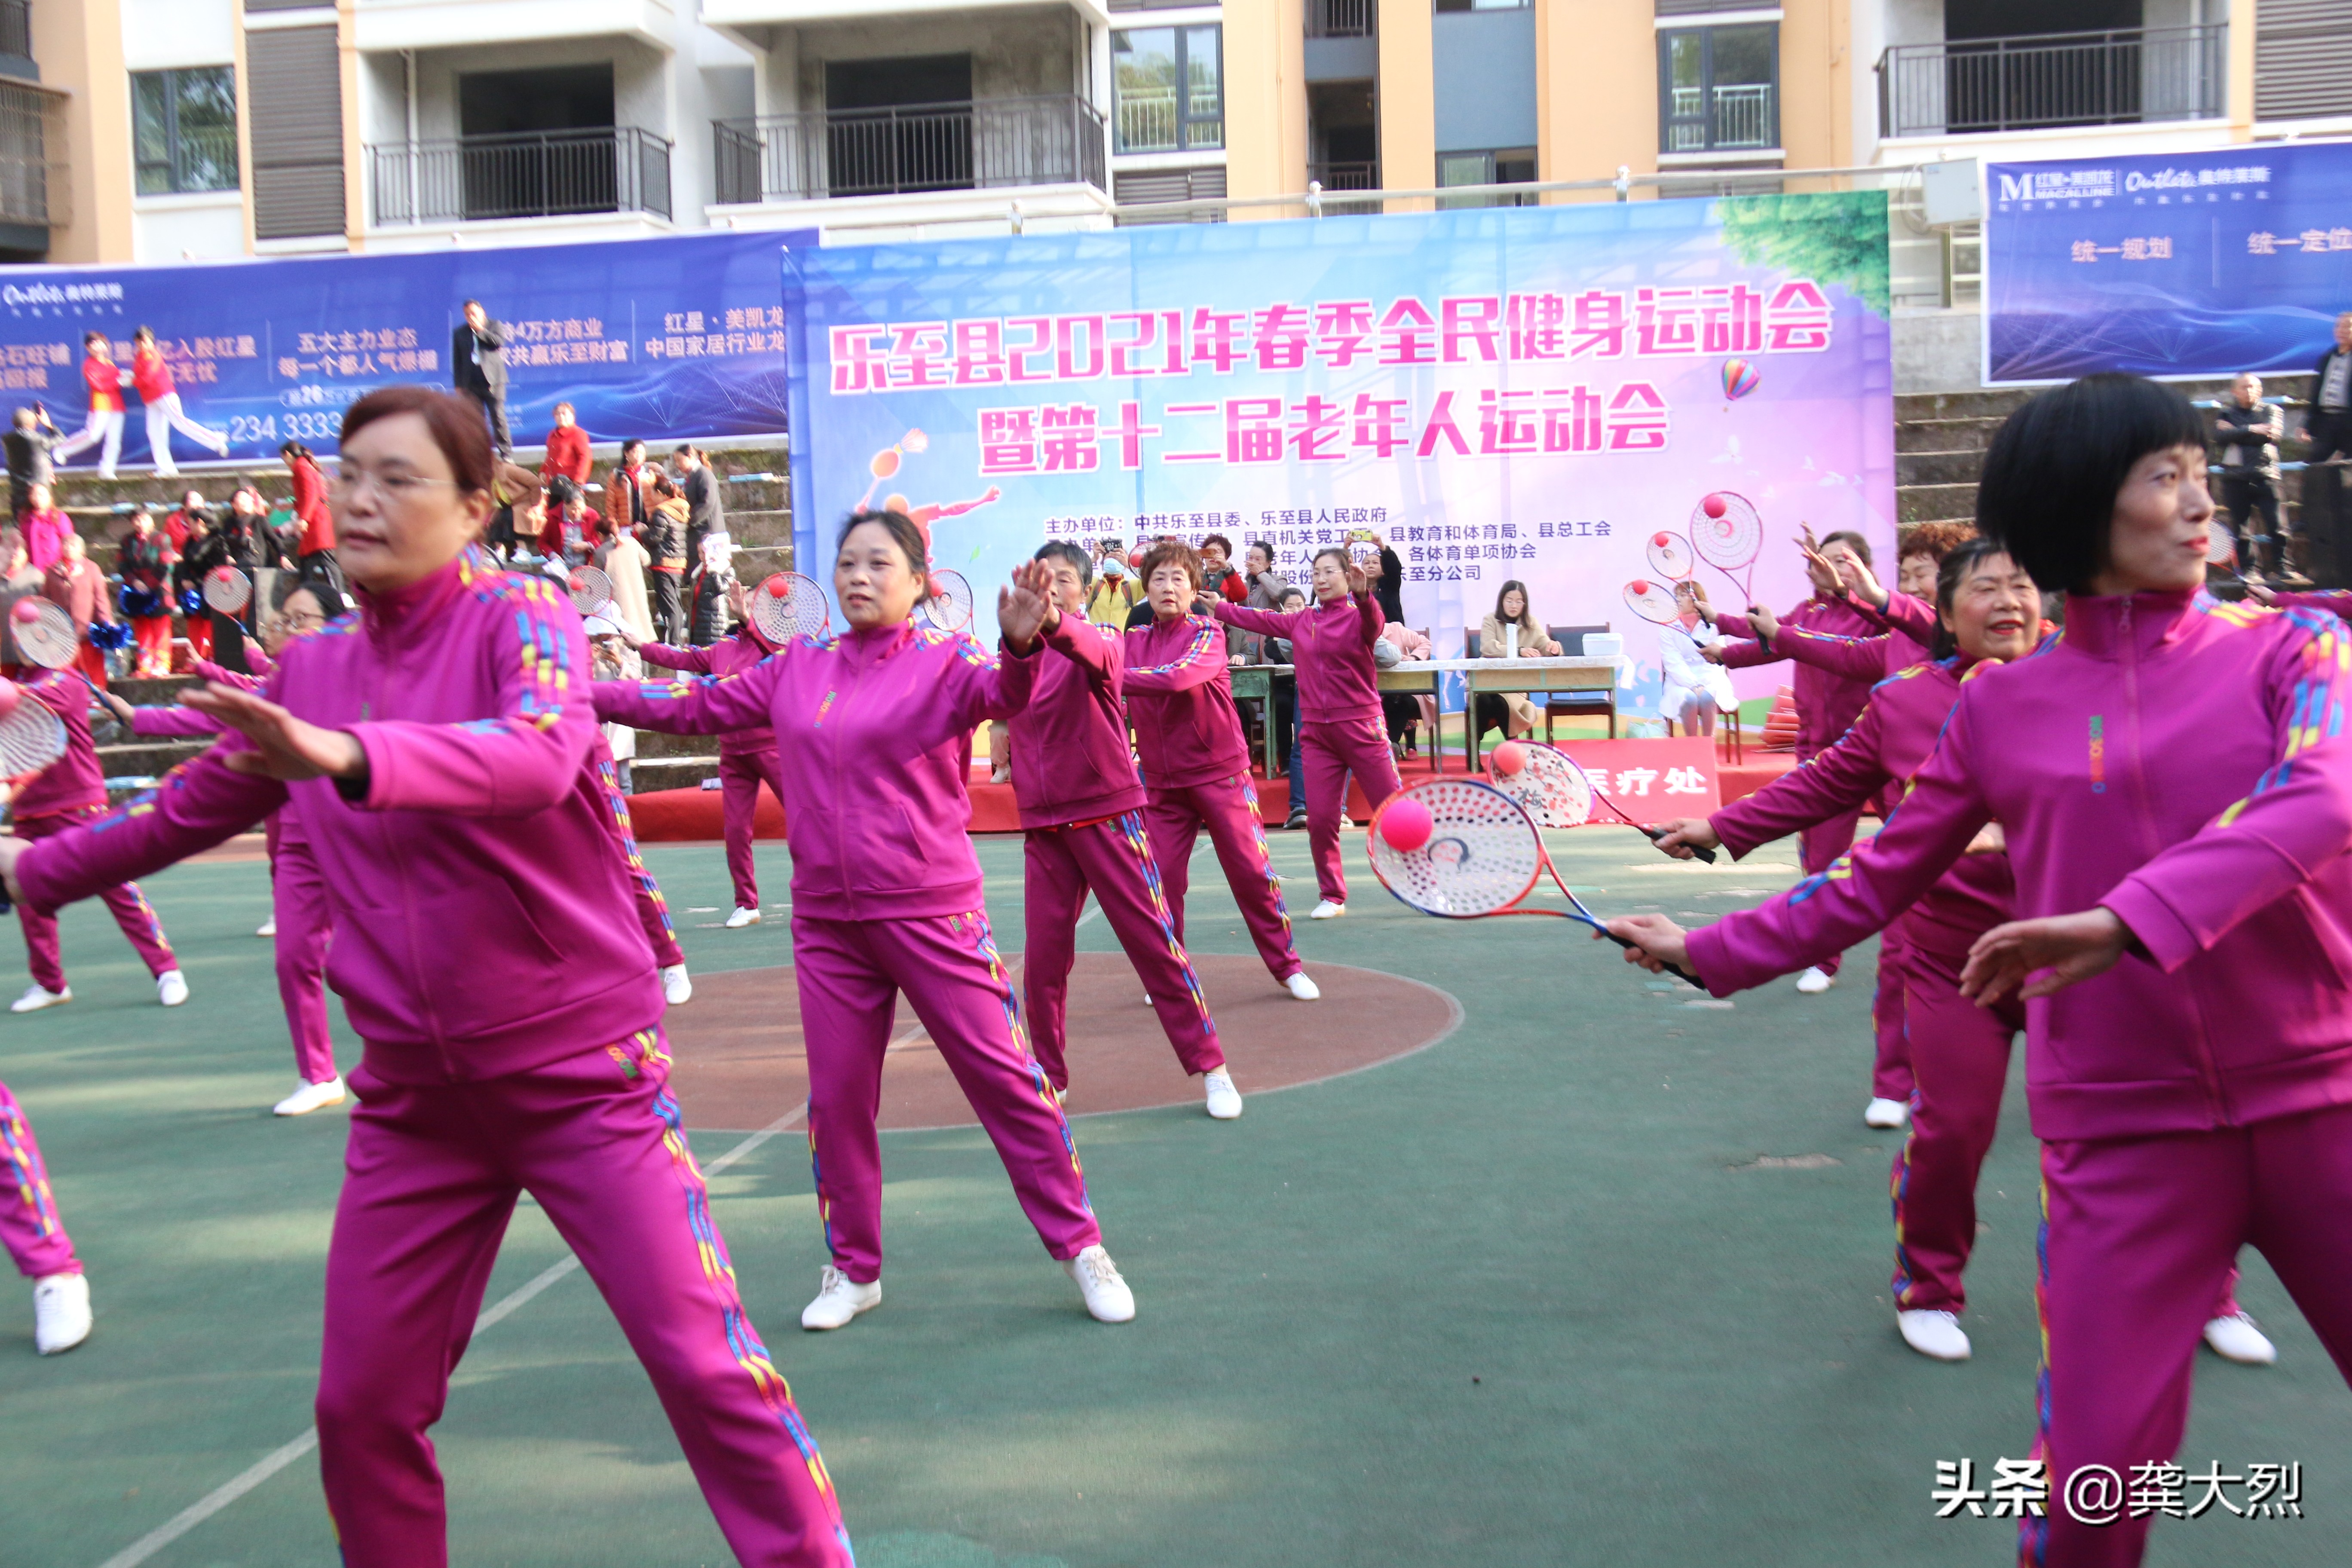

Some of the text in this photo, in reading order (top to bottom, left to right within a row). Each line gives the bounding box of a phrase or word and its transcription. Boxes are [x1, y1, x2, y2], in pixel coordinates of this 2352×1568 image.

[2071, 235, 2173, 263] 统一规划
[2247, 226, 2352, 254] 统一定位
[298, 327, 418, 354] 五大主力业态
[830, 279, 1832, 394] 乐至县2021年春季全民健身运动会
[168, 359, 218, 384] 无忧
[977, 381, 1671, 476] 暨第十二届老年人运动会
